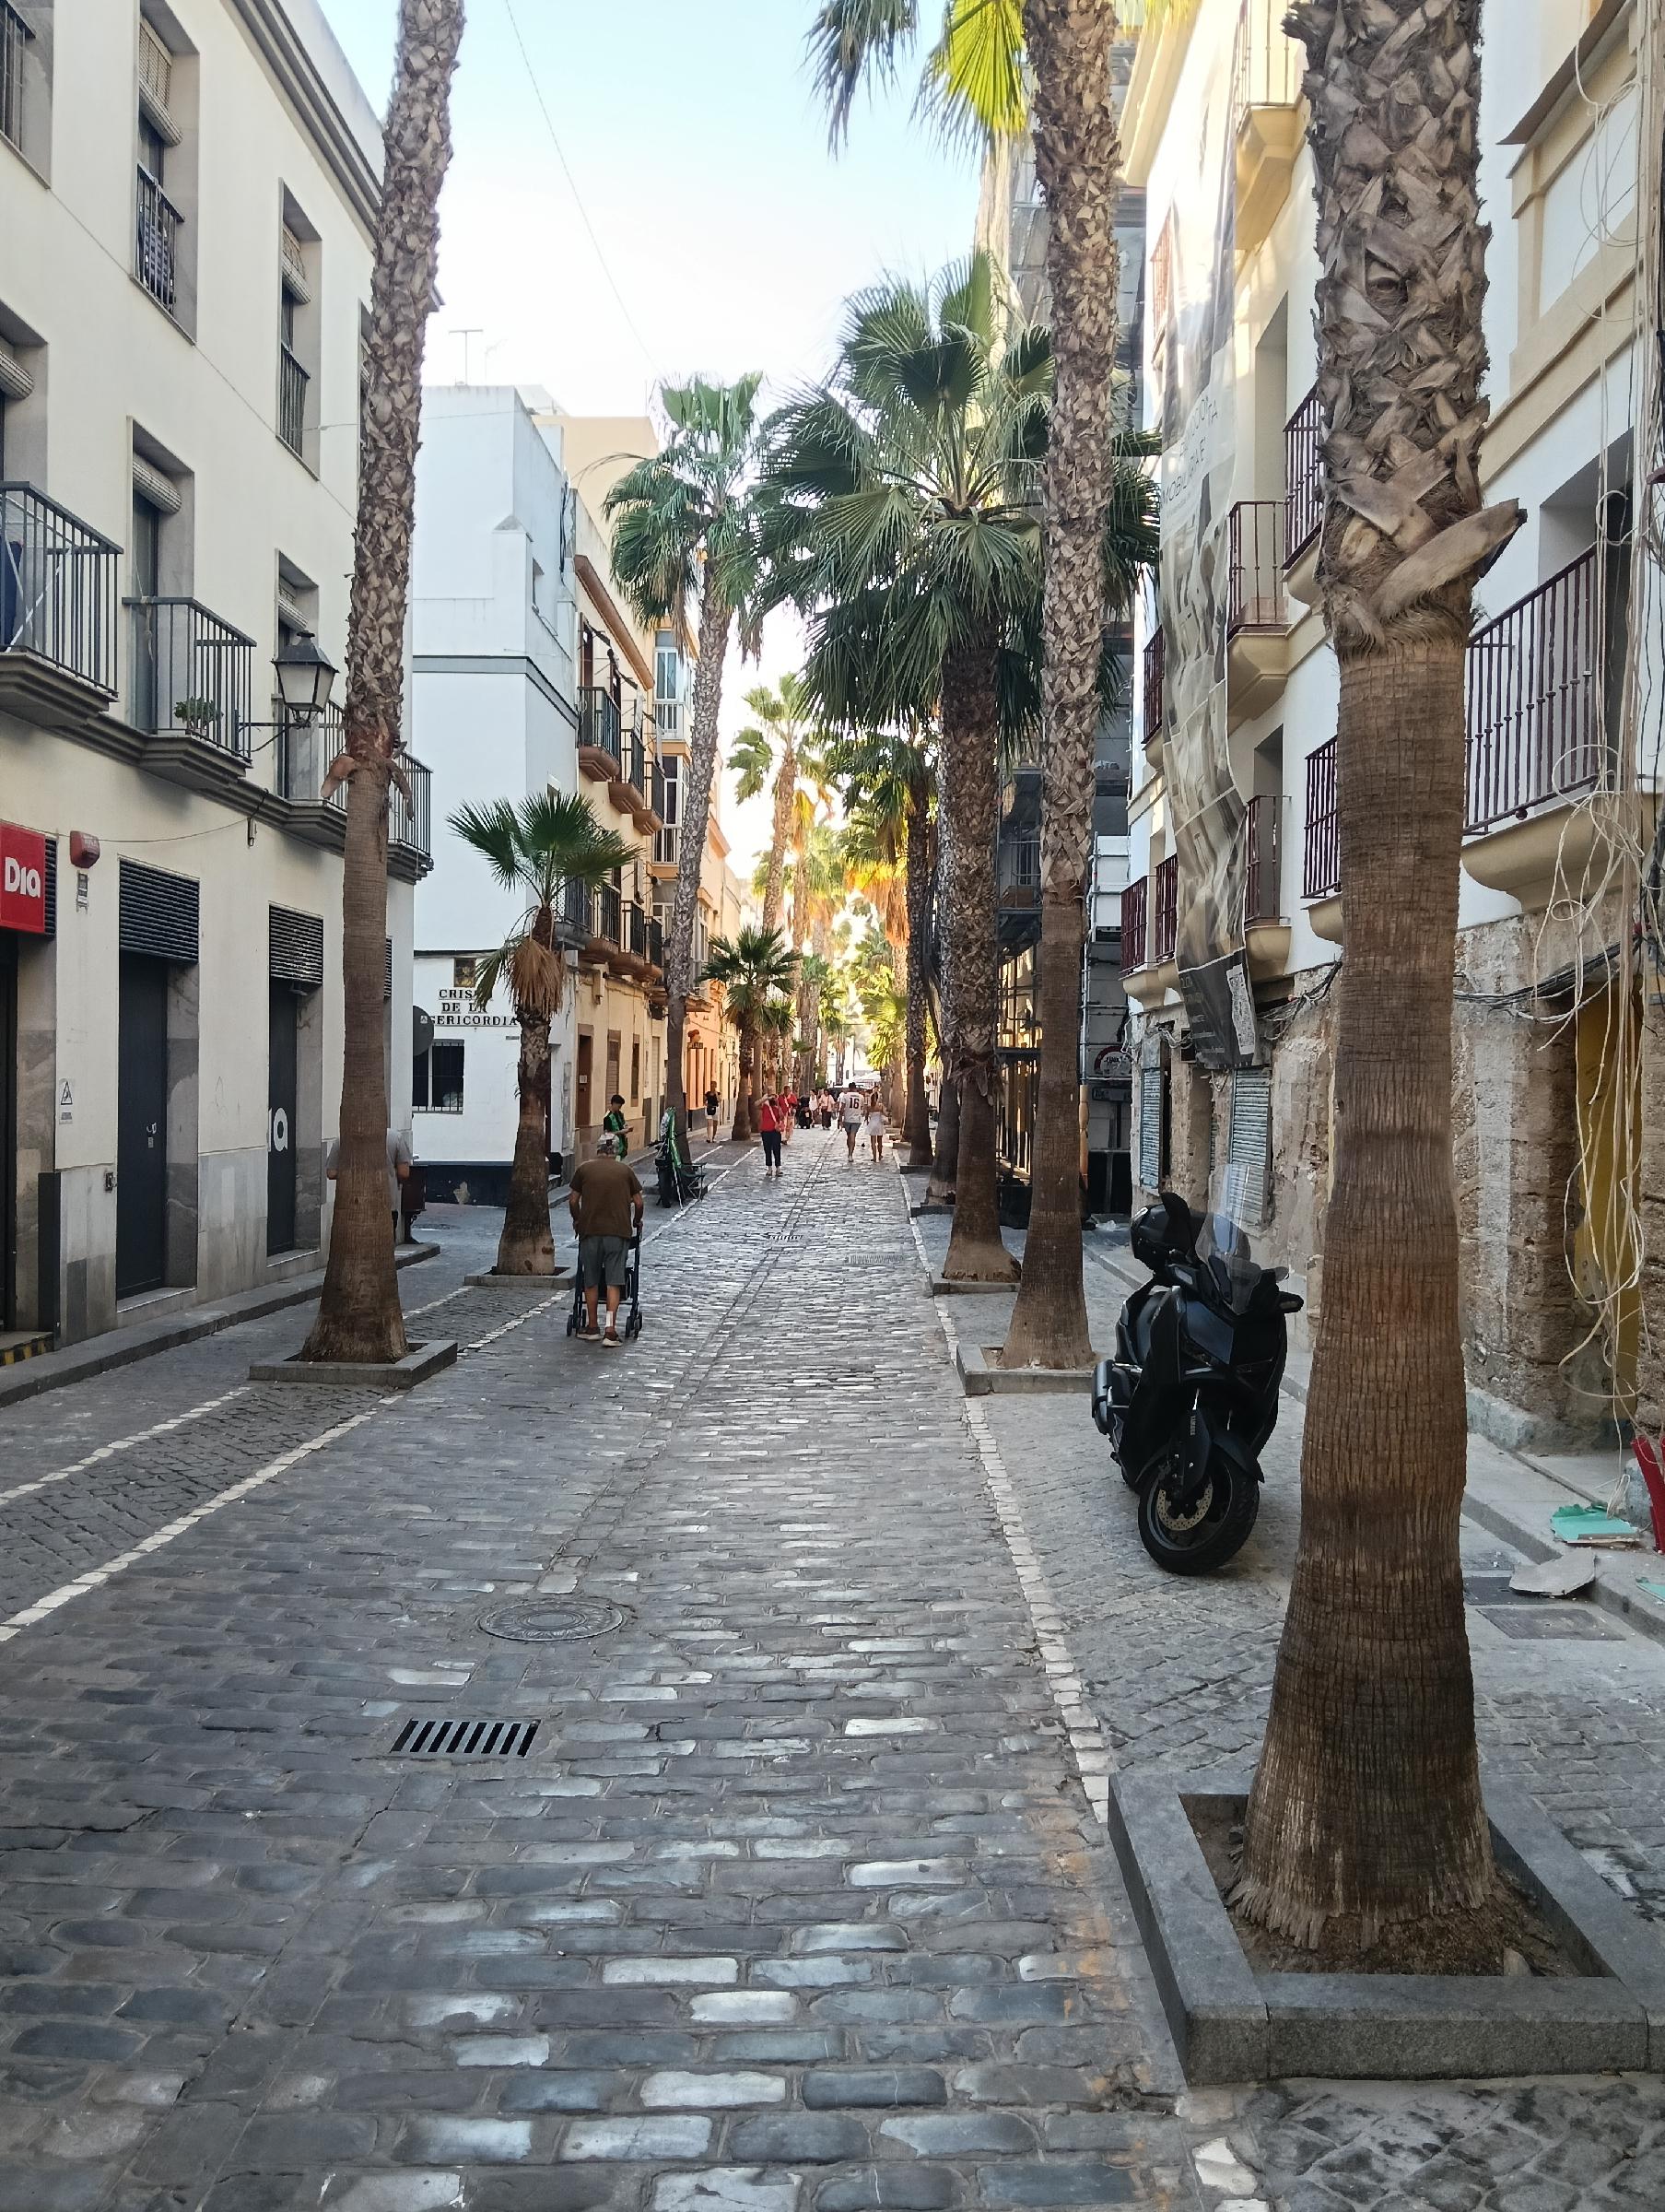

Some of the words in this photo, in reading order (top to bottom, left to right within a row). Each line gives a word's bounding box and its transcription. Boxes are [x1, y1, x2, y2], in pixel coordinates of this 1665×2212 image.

[5, 857, 41, 899] Dia
[442, 1003, 460, 1012] DE
[850, 1098, 860, 1109] 16
